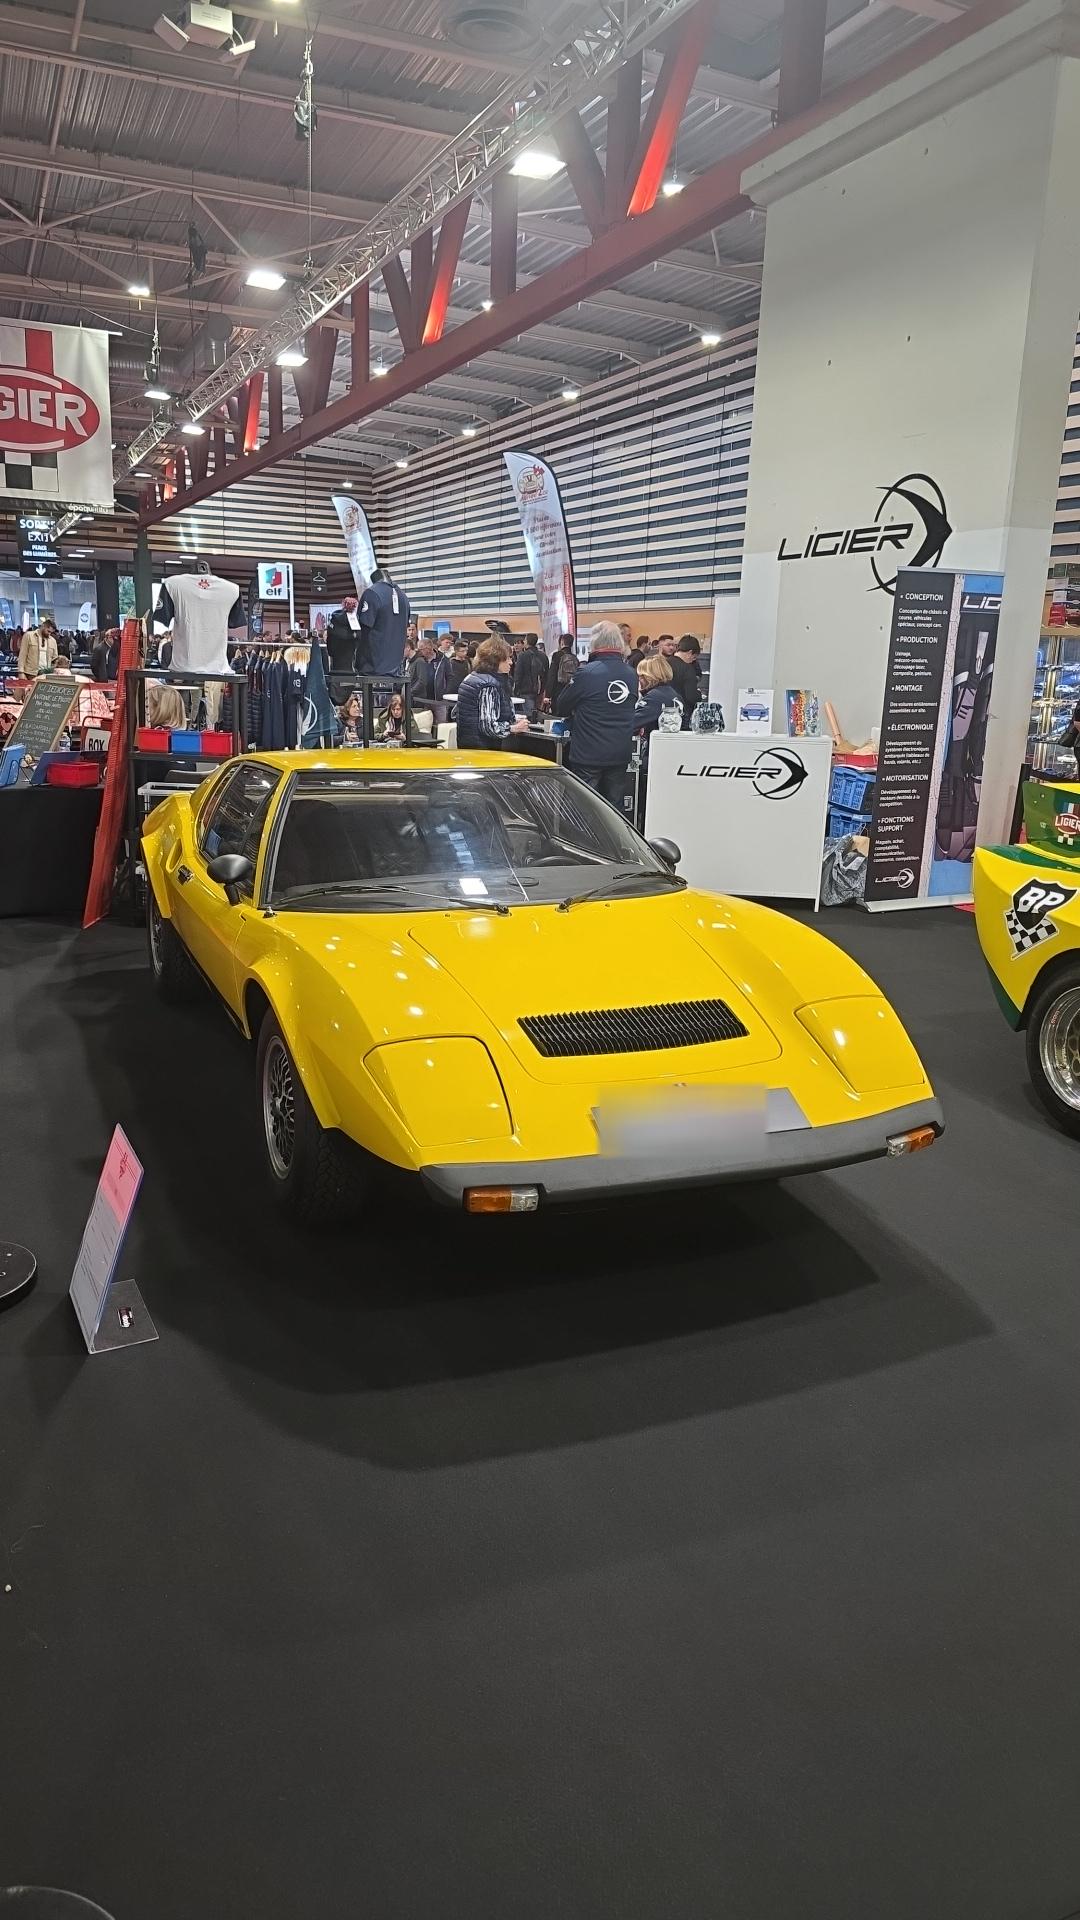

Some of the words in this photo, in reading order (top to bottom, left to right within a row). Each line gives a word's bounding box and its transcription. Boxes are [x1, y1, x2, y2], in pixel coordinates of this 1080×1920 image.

[777, 523, 914, 561] LIGIER
[266, 587, 282, 597] elf
[905, 593, 944, 601] CONCEPTION
[895, 684, 923, 692] MONTAGE
[891, 723, 934, 731] ÉLECTRONIQUE
[676, 764, 782, 780] LIGIER
[877, 825, 904, 833] SUPPORT
[1017, 886, 1065, 914] BP
